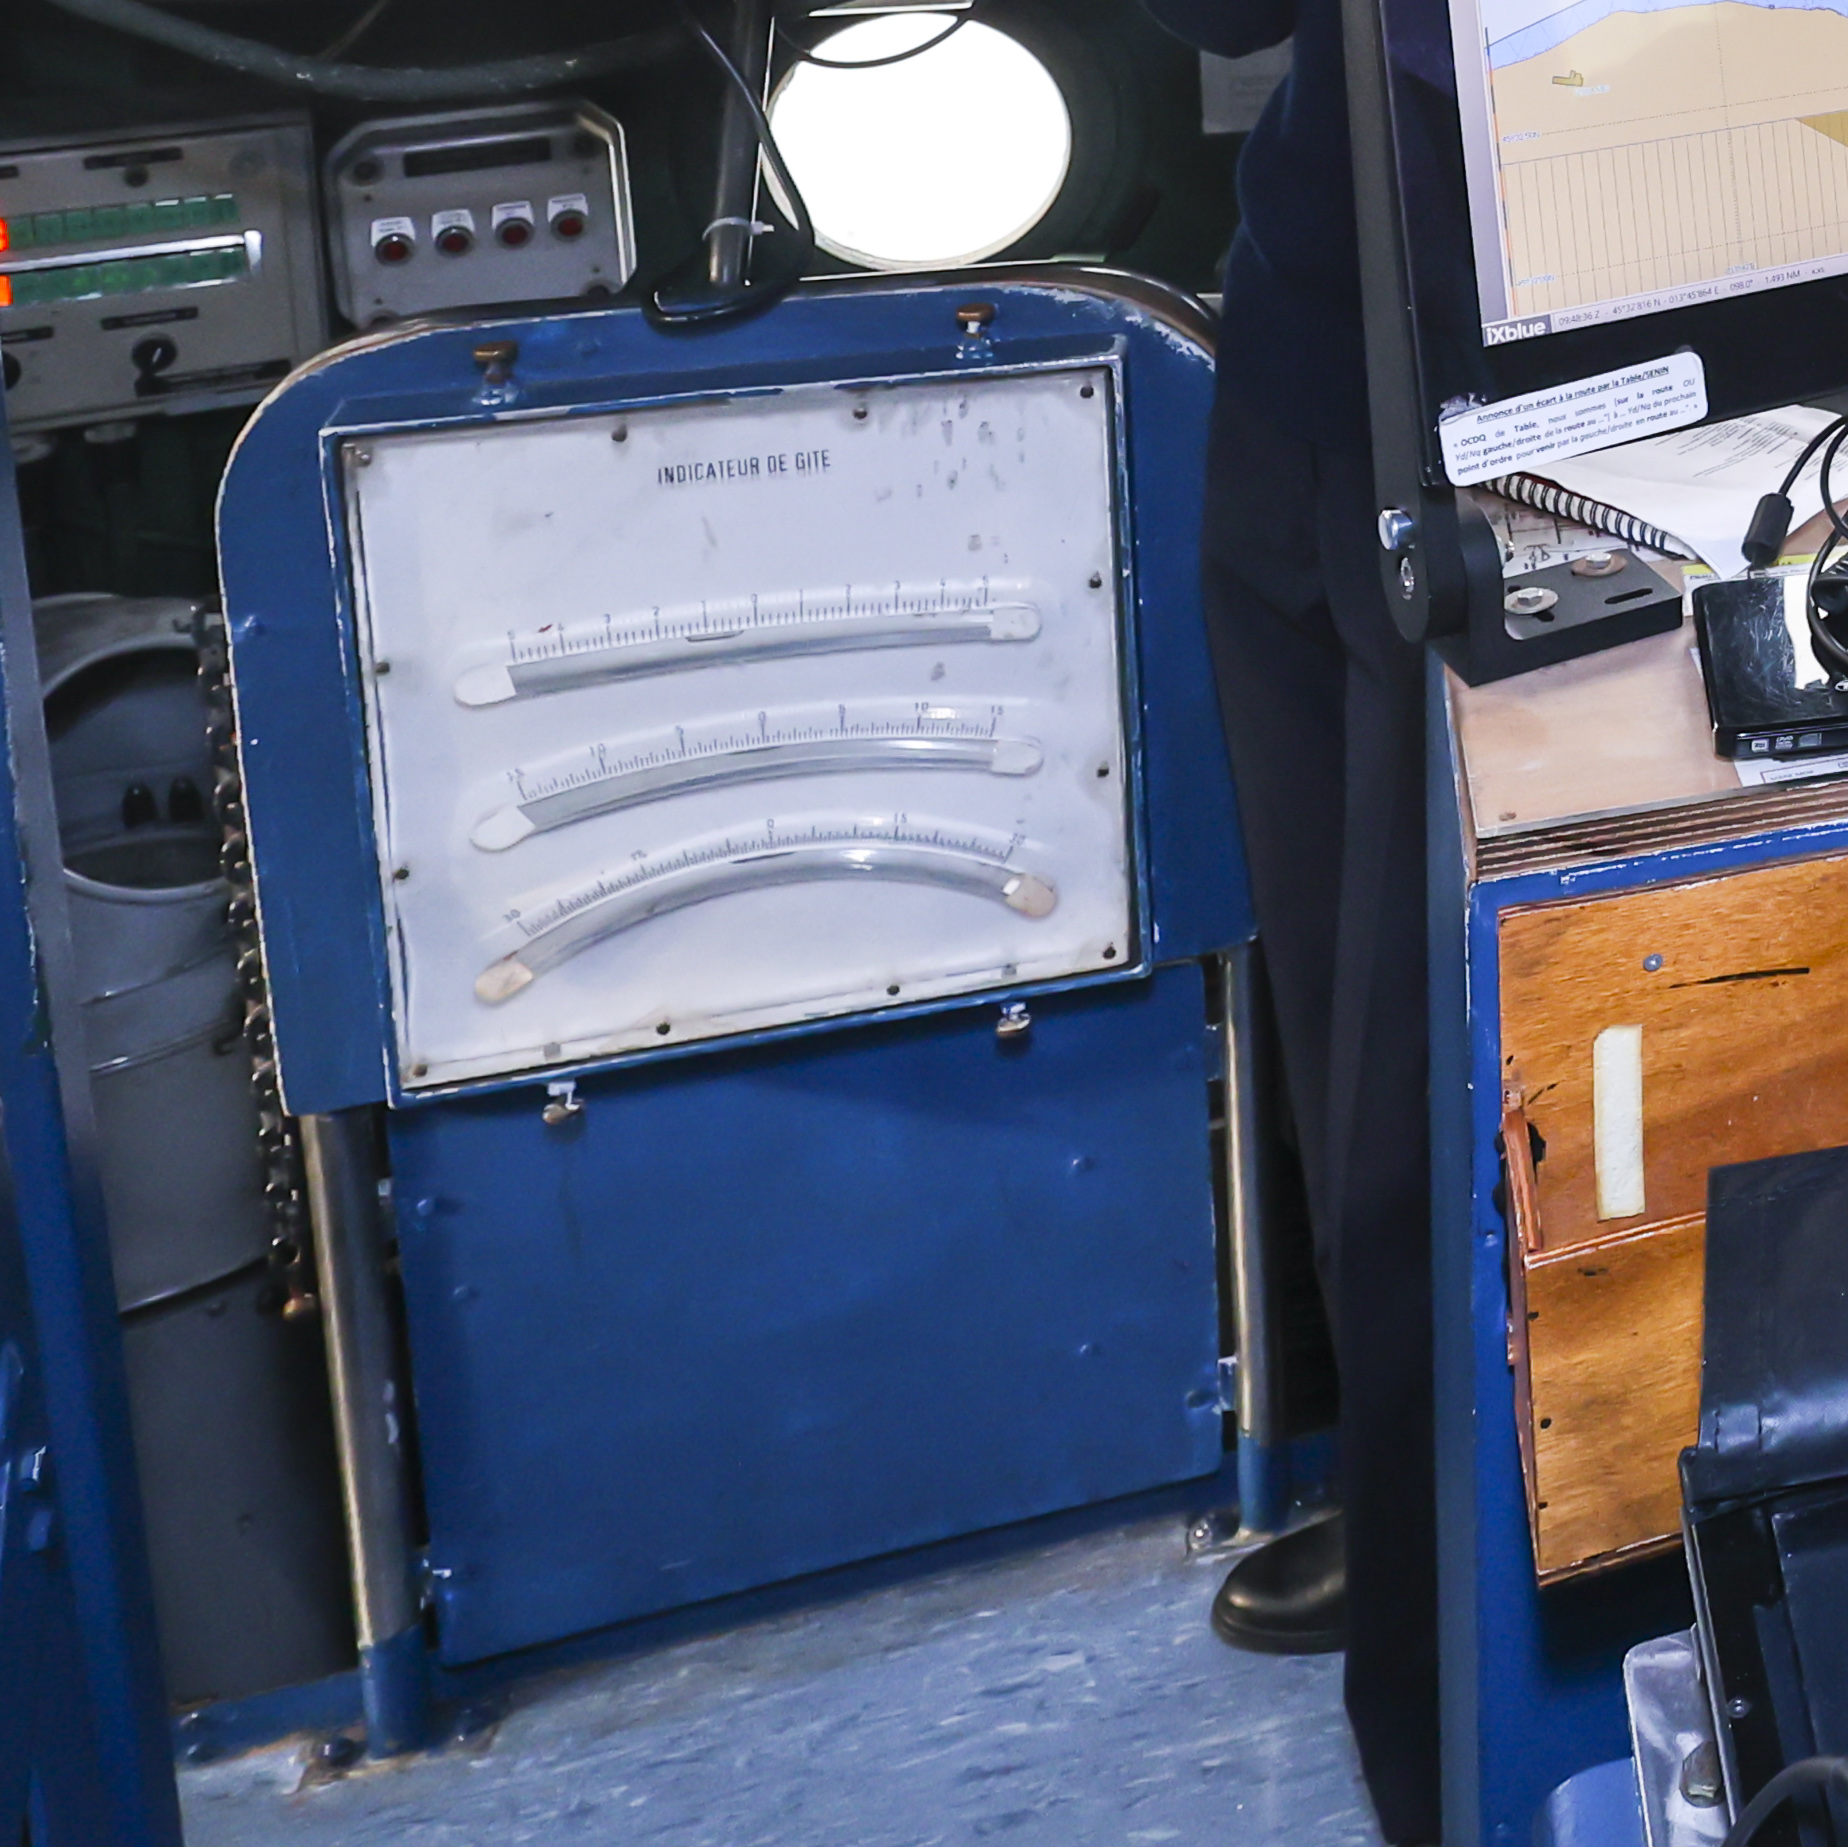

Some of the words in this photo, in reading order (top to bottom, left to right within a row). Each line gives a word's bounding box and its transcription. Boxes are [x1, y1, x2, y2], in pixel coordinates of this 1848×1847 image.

[1652, 297, 1661, 307] N
[1714, 286, 1719, 295] E
[1786, 270, 1801, 280] NM
[1486, 320, 1546, 346] iXblue
[1476, 408, 1513, 424] Annonce
[1515, 402, 1534, 415] d'un
[1536, 396, 1556, 409] écart
[1559, 393, 1564, 402] à
[1565, 392, 1572, 401] la
[1574, 385, 1596, 399] route
[1597, 383, 1610, 395] par
[1612, 379, 1619, 388] la
[1621, 366, 1669, 387] Table/SENIN
[1461, 434, 1486, 447] OCDQ
[1495, 429, 1505, 438] de
[1514, 421, 1540, 433] Table,
[1548, 413, 1567, 424] nous
[1574, 403, 1606, 417] sommes
[1637, 392, 1644, 400] la
[1651, 385, 1673, 396] route
[1483, 433, 1542, 456] gauche/droite
[1544, 428, 1554, 438] de
[1555, 426, 1562, 435] la
[1563, 421, 1586, 433] route
[1587, 418, 1596, 427] au
[1664, 391, 1697, 407] prochain
[1457, 463, 1480, 476] point
[1481, 453, 1513, 469] d'ordre
[1516, 448, 1535, 461] pour
[1536, 442, 1555, 454] venir
[1557, 437, 1570, 448] par
[1571, 435, 1578, 443] la
[1580, 419, 1633, 442] gauche/droite
[1647, 411, 1668, 423] route
[658, 457, 759, 486] INDICATEUR
[768, 454, 787, 473] DE
[796, 449, 831, 471] GITE
[990, 705, 1004, 716] 15
[893, 813, 907, 824] 15
